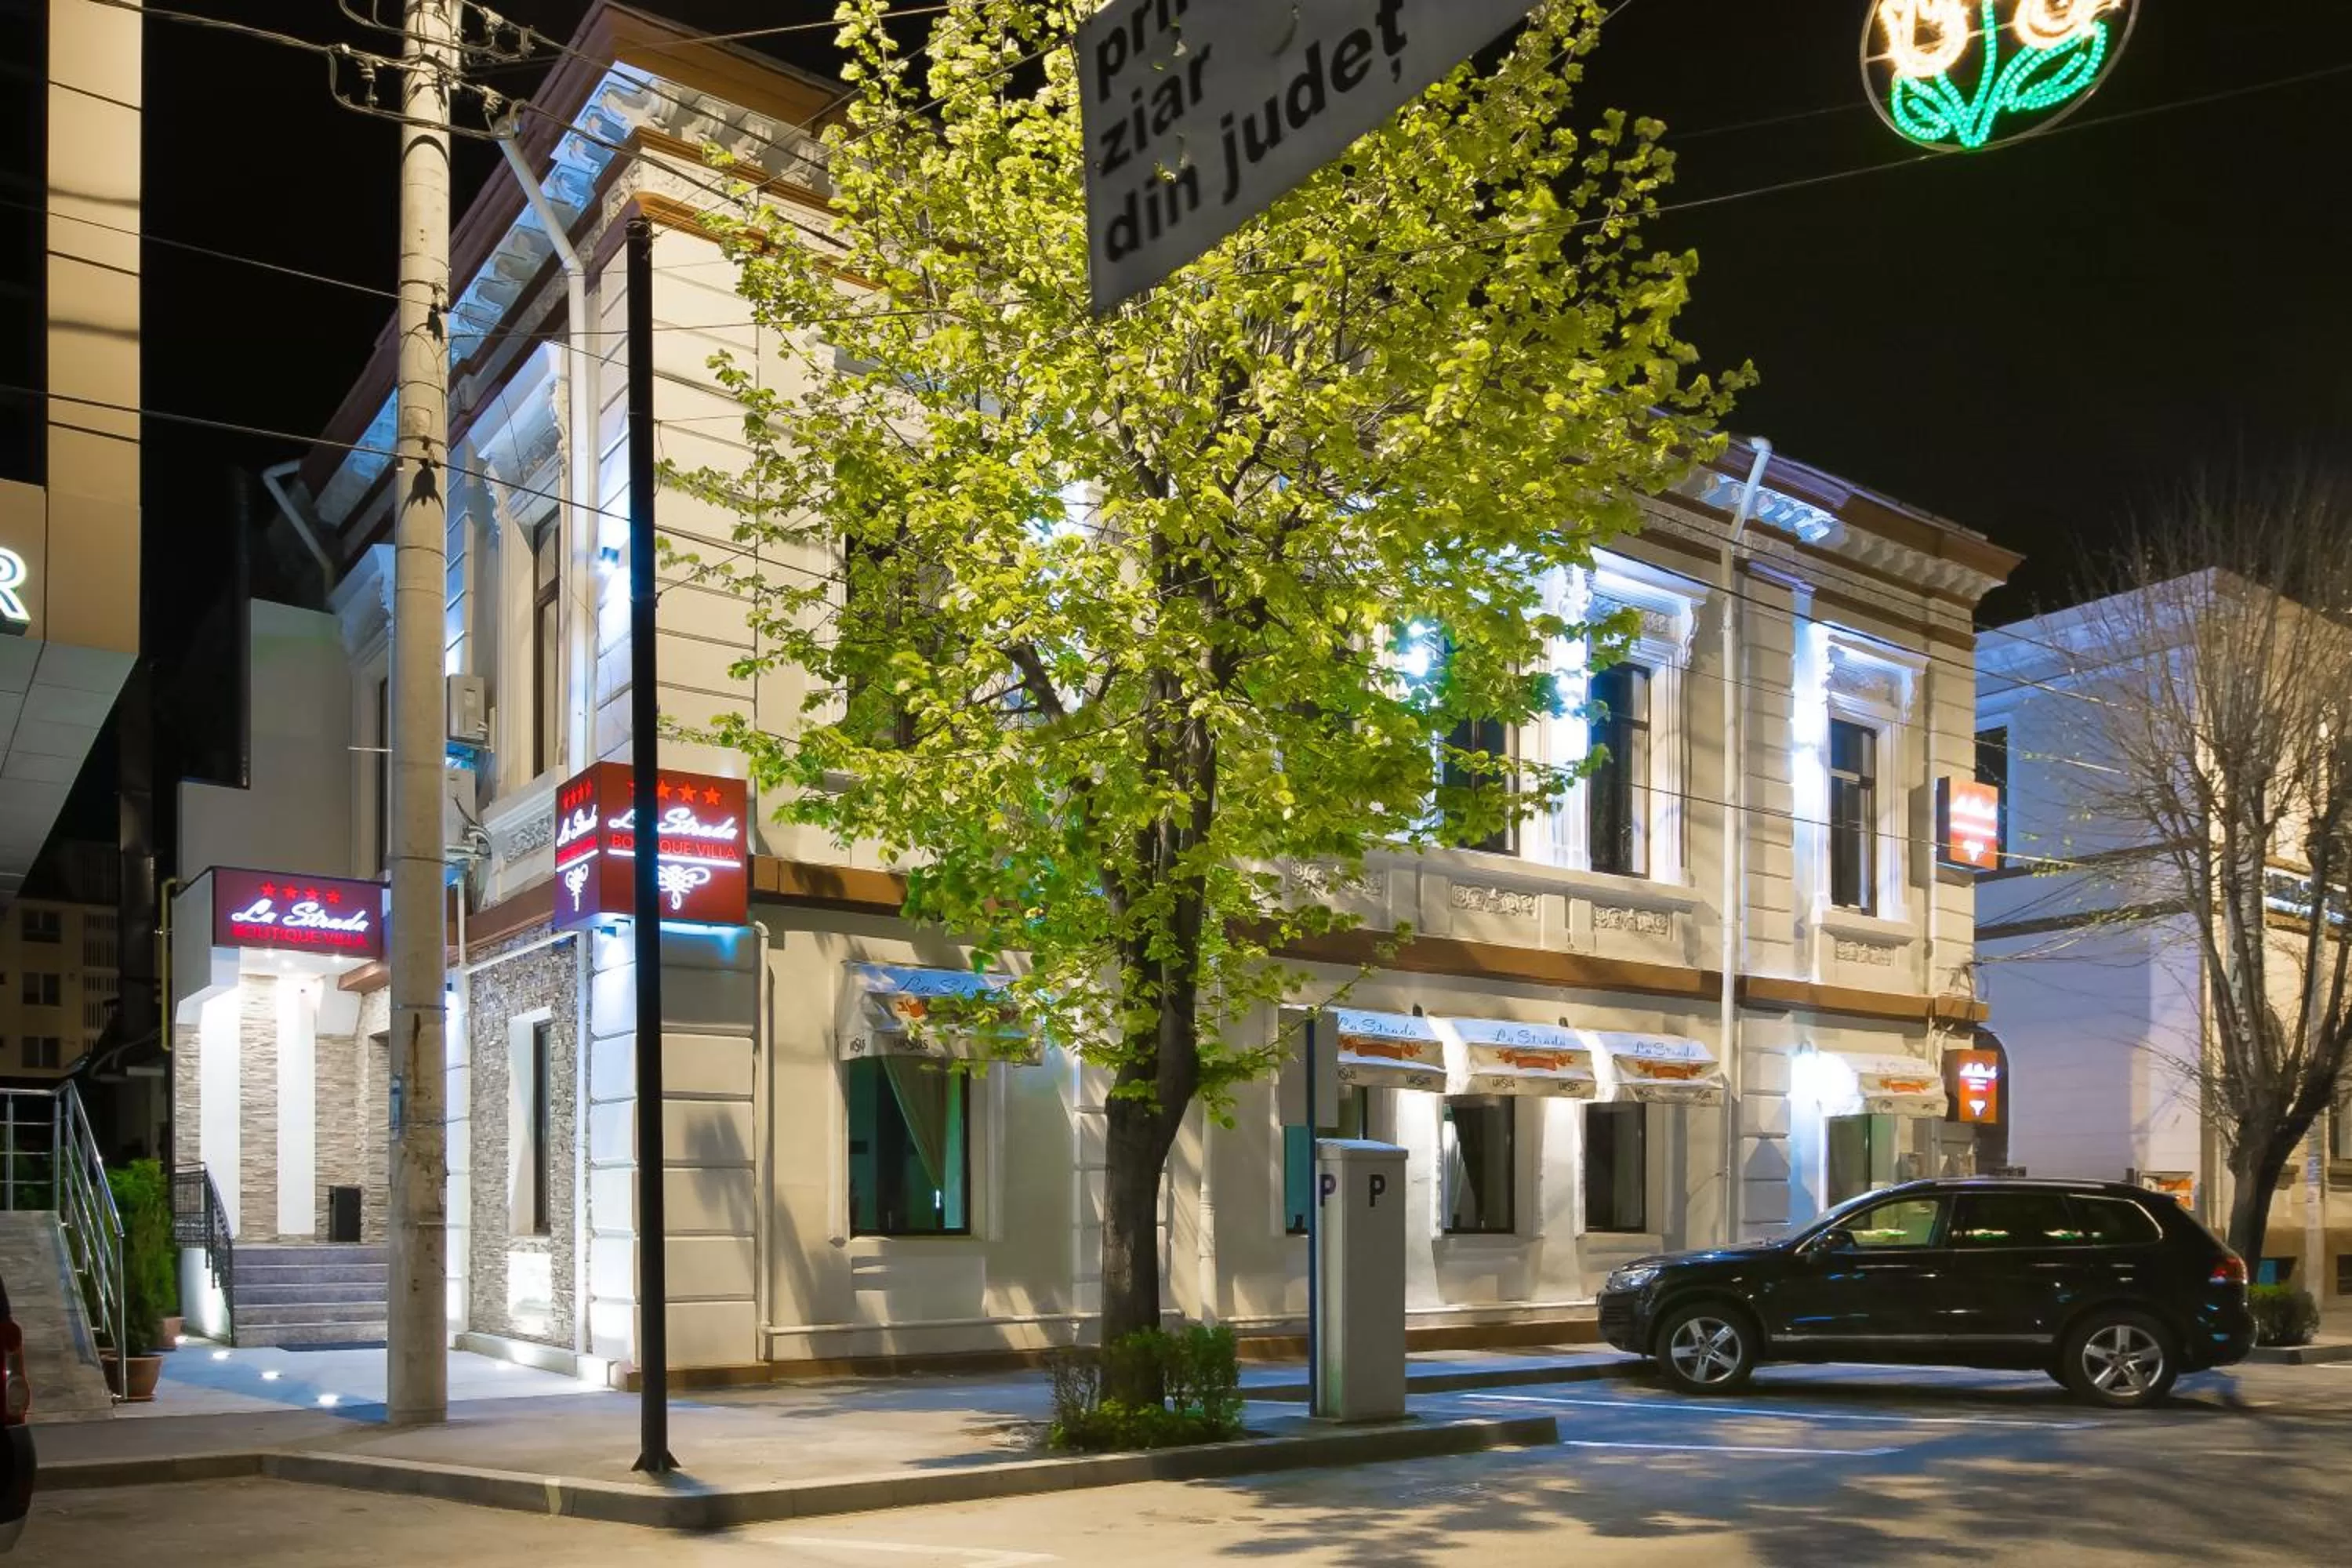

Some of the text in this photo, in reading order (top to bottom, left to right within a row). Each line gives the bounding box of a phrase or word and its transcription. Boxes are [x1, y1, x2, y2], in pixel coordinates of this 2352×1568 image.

[1096, 0, 1189, 103] pri
[1100, 44, 1211, 177] ziar
[1105, 0, 1408, 263] din județ
[612, 834, 691, 855] BOQUE
[696, 842, 737, 860] VILLA
[231, 898, 369, 932] La Strada
[232, 924, 321, 944] BOUTIQUE
[1319, 1174, 1337, 1207] P
[1369, 1174, 1385, 1207] P
